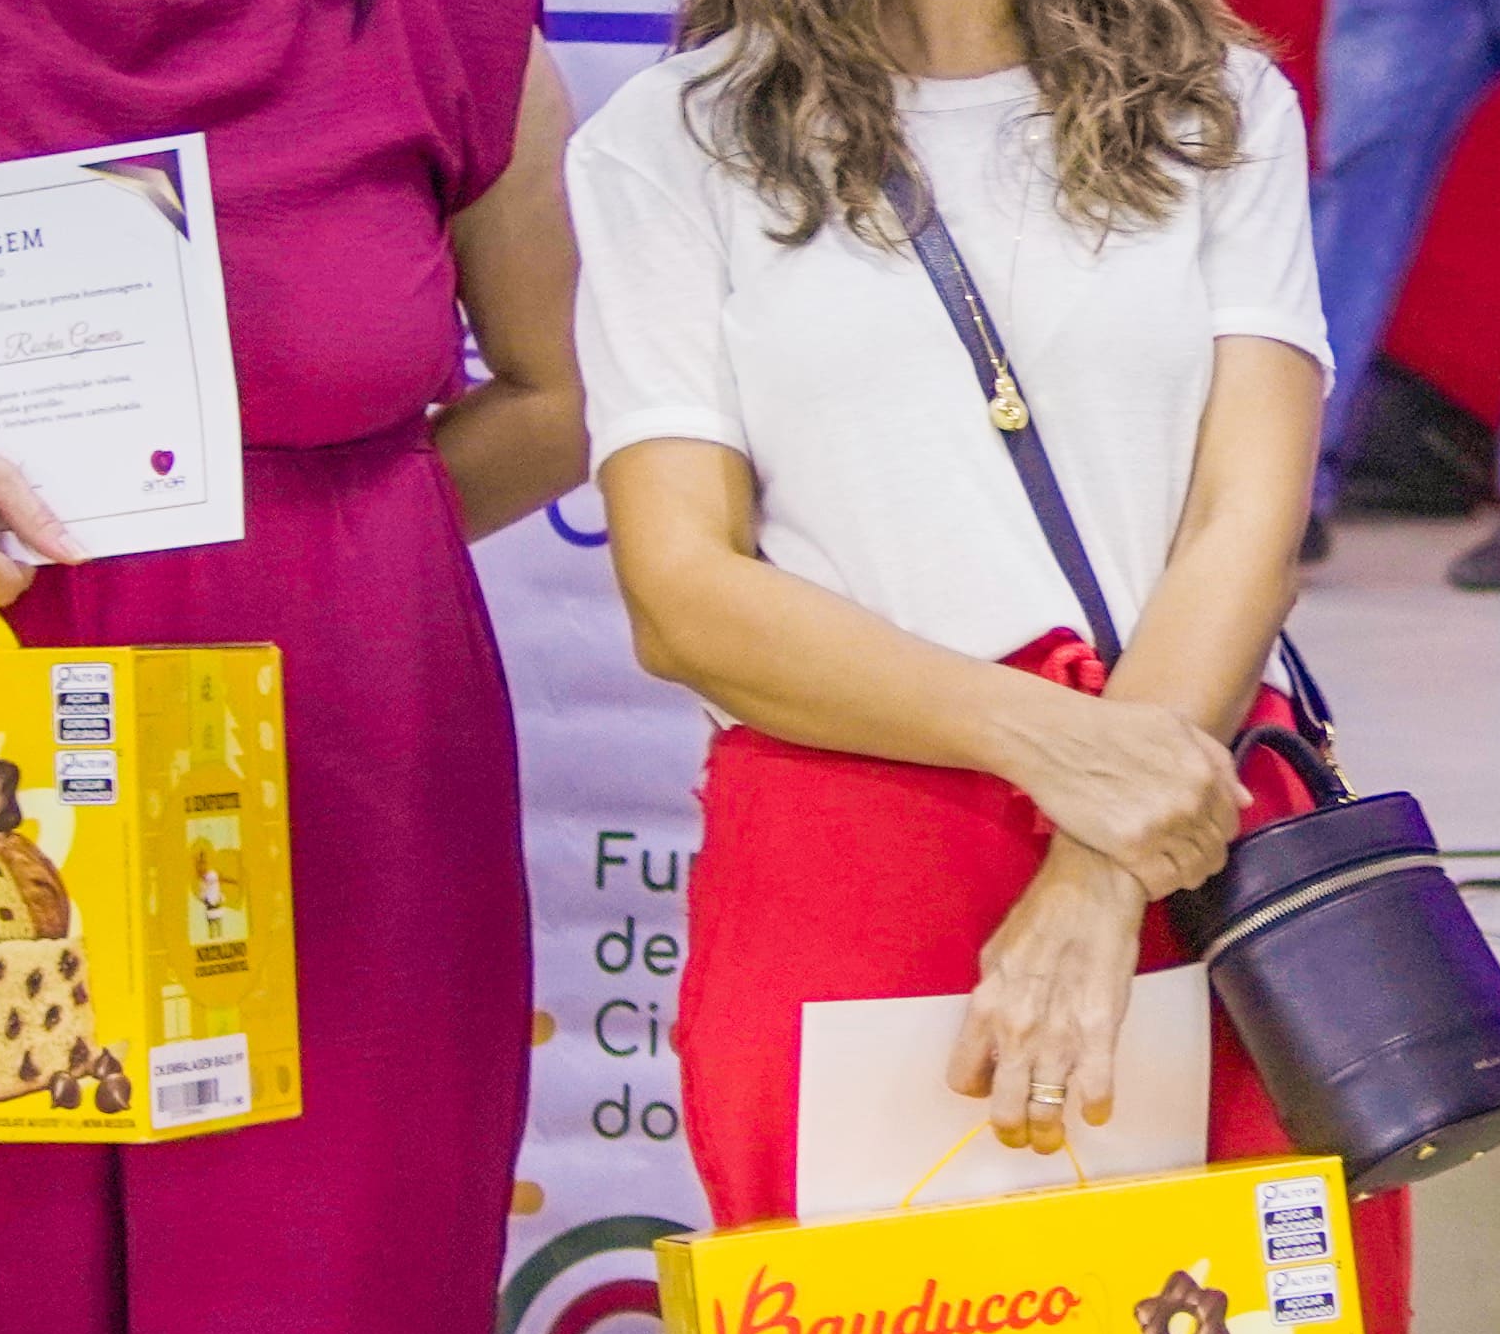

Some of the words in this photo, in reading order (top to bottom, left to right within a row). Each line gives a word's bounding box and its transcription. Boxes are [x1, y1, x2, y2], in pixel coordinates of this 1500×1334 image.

[596, 830, 697, 893] Fu
[595, 914, 680, 976] de
[592, 1082, 679, 1142] do
